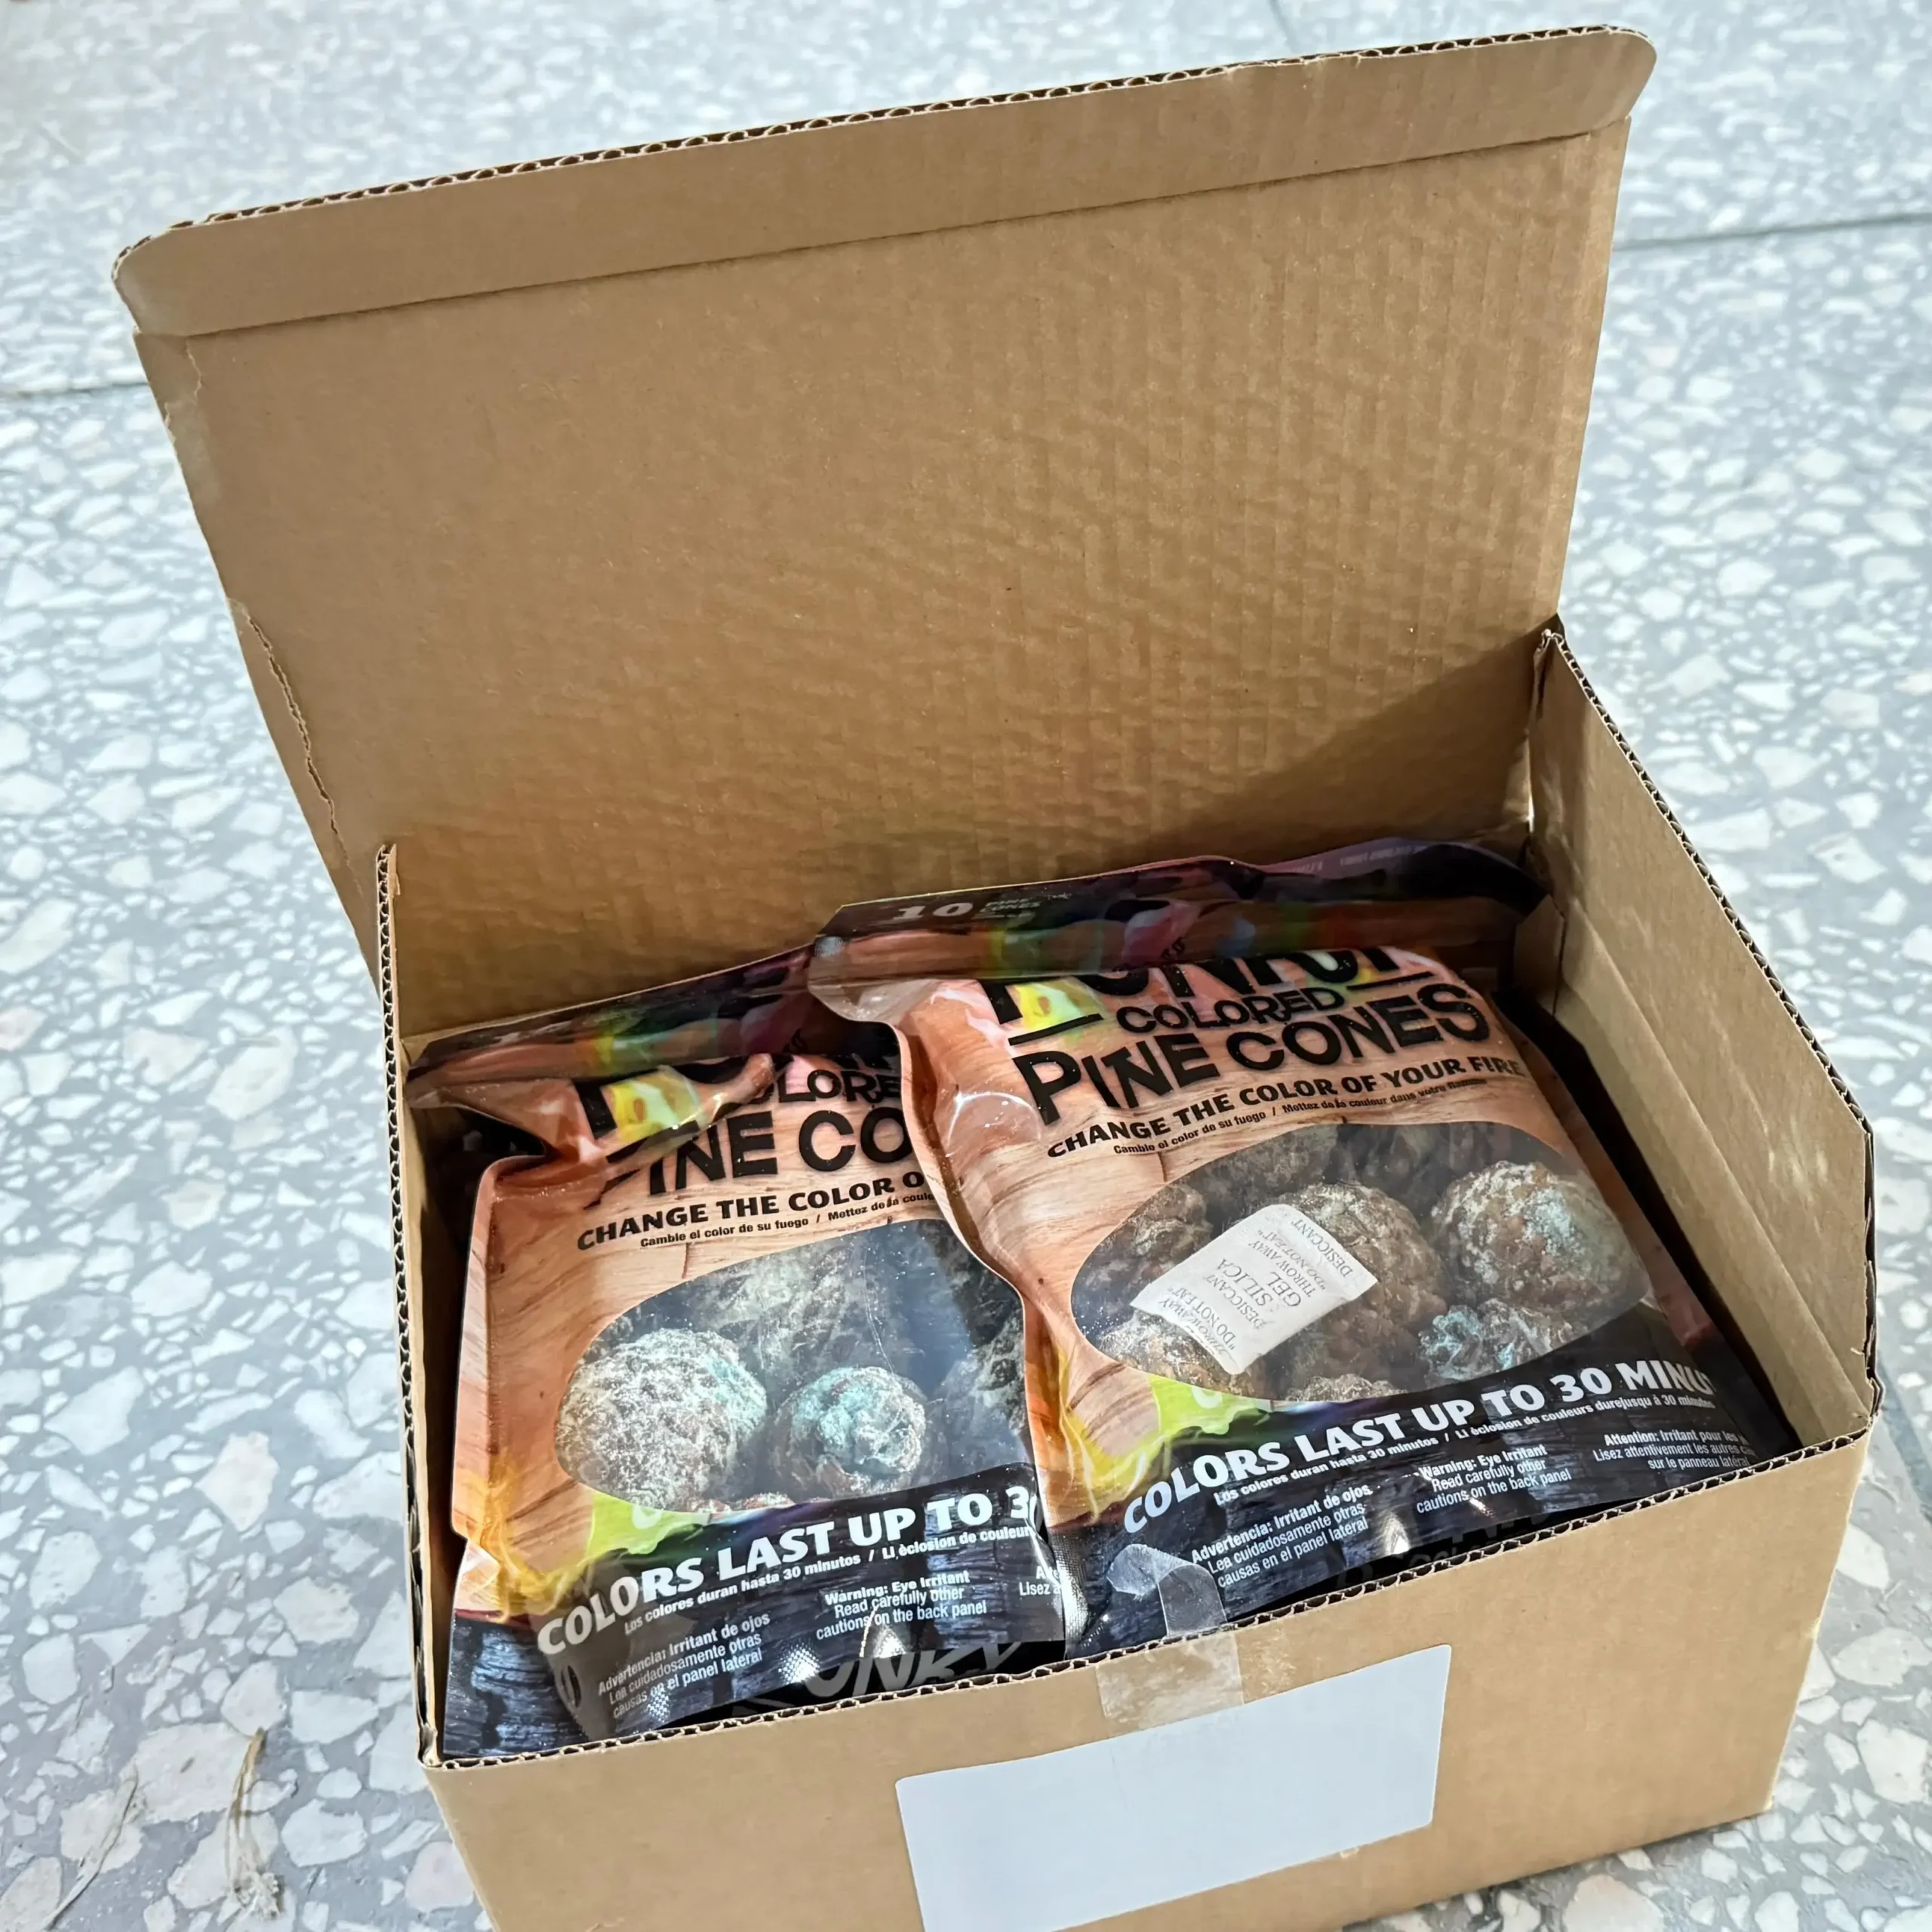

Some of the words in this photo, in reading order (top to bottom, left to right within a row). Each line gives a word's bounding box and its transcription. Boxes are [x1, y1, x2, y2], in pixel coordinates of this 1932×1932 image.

[1116, 987, 1345, 1033] COLORED
[1013, 1033, 1220, 1126] PINE
[1226, 984, 1490, 1071] CONES
[1048, 1117, 1171, 1158] CHANGE
[1173, 1094, 1235, 1126] THE
[1238, 1075, 1339, 1106] COLOR
[1340, 1075, 1377, 1095] OF
[1381, 1059, 1466, 1088] YOUR
[1466, 1057, 1526, 1077] FIRE
[1171, 1128, 1200, 1146] color
[1202, 1124, 1217, 1134] de
[1219, 1118, 1232, 1129] su
[1234, 1111, 1266, 1127] fuego
[1349, 1097, 1387, 1107] couleur
[577, 1205, 709, 1251] CHANGE
[716, 1195, 780, 1220] THE
[789, 1178, 895, 1211] COLOR
[903, 1171, 924, 1189] O
[690, 1230, 700, 1240] el
[704, 1226, 735, 1238] color
[739, 1223, 753, 1233] de
[757, 1221, 771, 1231] su
[775, 1218, 809, 1230] fuego
[828, 1207, 868, 1220] Mettez
[903, 1192, 935, 1203] coule
[1290, 1218, 1354, 1278] DESICCANT
[1215, 1257, 1274, 1306] SILICA
[1265, 1270, 1302, 1307] GEL
[1275, 1259, 1316, 1298] THROW
[1191, 1300, 1220, 1328] NOT
[1124, 1442, 1291, 1533] COLORS
[1294, 1413, 1405, 1463] LAST
[1412, 1399, 1475, 1432] UP
[1481, 1384, 1545, 1417] TO
[1549, 1367, 1613, 1403] 30
[1615, 1360, 1716, 1395] MINU
[1214, 1487, 1239, 1506] Los
[1241, 1474, 1289, 1495] colores
[1291, 1462, 1329, 1480] duran
[1331, 1454, 1367, 1469] hasta
[1367, 1448, 1386, 1459] 30
[1388, 1437, 1439, 1456] minutos
[1524, 1415, 1540, 1426] de
[1541, 1404, 1594, 1423] couleurs
[1663, 1395, 1676, 1406] 30
[1417, 1457, 1477, 1478] Warning:
[1477, 1454, 1502, 1468] Eye
[1502, 1444, 1548, 1462] Irritant
[1593, 1449, 1623, 1462] Lisez
[1624, 1441, 1694, 1458] attentivement
[1693, 1442, 1709, 1454] les
[1709, 1442, 1740, 1454] autres
[1604, 1432, 1660, 1447] Attention:
[1660, 1429, 1699, 1442] Irritant
[1699, 1431, 1722, 1443] pour
[1432, 1474, 1464, 1493] Read
[1465, 1463, 1514, 1484] carefully
[1517, 1458, 1546, 1474] other
[1647, 1460, 1665, 1470] sur
[1666, 1457, 1677, 1468] le
[1677, 1457, 1720, 1471] panneau
[1417, 1489, 1469, 1514] cautions
[1472, 1485, 1486, 1498] on
[1487, 1480, 1508, 1495] the
[1509, 1475, 1540, 1491] back
[1540, 1468, 1572, 1487] panel
[1192, 1522, 1273, 1564] Advertencia:
[1273, 1499, 1321, 1530] Irritant
[1323, 1495, 1340, 1514] de
[1342, 1484, 1371, 1503] ojos
[1208, 1556, 1233, 1574] Lea
[1234, 1514, 1332, 1563] cuidadosamente
[1334, 1502, 1365, 1523] otras
[537, 1558, 704, 1655] COLORS
[718, 1521, 835, 1580] LAST
[848, 1508, 916, 1546] UP
[928, 1494, 993, 1533] TO
[1217, 1561, 1260, 1588] causas
[1263, 1556, 1278, 1569] en
[1281, 1548, 1293, 1562] el
[1297, 1534, 1328, 1559] panel
[1330, 1515, 1369, 1543] lateral
[624, 1617, 643, 1635] Los
[645, 1597, 694, 1623] colores
[697, 1584, 737, 1604] duran
[741, 1571, 780, 1591] hasta
[783, 1565, 801, 1580] 30
[804, 1555, 861, 1576] minutos
[958, 1531, 977, 1546] de
[980, 1525, 1031, 1543] couleur
[824, 1586, 888, 1606] Warning:
[891, 1580, 918, 1594] Eye
[920, 1570, 971, 1588] Irritant
[834, 1599, 868, 1619] Read
[872, 1589, 928, 1610] carefully
[931, 1586, 965, 1601] other
[1019, 1581, 1051, 1596] Lisez
[669, 1628, 718, 1657] Irritant
[721, 1623, 739, 1639] de
[742, 1612, 771, 1632] ojos
[816, 1615, 872, 1641] cautions
[874, 1614, 890, 1626] on
[893, 1609, 913, 1623] the
[917, 1604, 949, 1620] back
[952, 1600, 987, 1619] panel
[613, 1689, 648, 1718] causas
[667, 1673, 679, 1690] el
[682, 1659, 718, 1686] panel
[721, 1647, 763, 1672] lateral
[629, 1644, 726, 1691] cuidadosamente
[729, 1633, 762, 1654] otras
